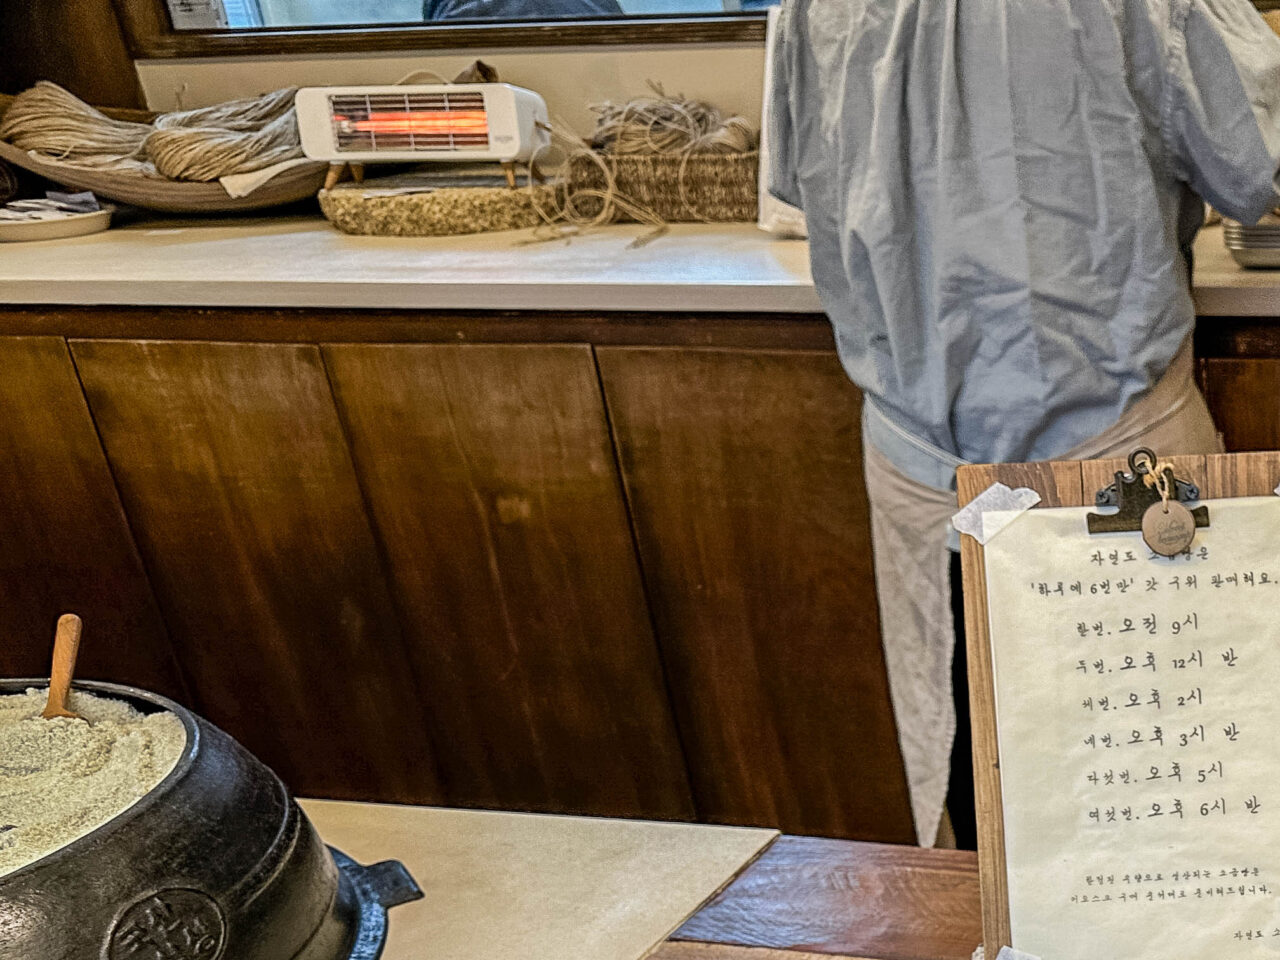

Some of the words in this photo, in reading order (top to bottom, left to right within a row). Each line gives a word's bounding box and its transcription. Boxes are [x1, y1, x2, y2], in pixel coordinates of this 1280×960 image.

[1118, 612, 1157, 635] 오전
[1171, 612, 1198, 635] 9시
[1119, 651, 1157, 673] 오후
[1171, 649, 1203, 669] 12시
[1221, 647, 1239, 667] 반
[1124, 688, 1161, 710] 오후
[1177, 687, 1203, 707] 2시
[1127, 725, 1164, 747] 오후
[1179, 724, 1205, 747] 3시
[1223, 722, 1240, 742] 반
[1145, 761, 1182, 783] 오후
[1197, 760, 1223, 784] 5시
[1147, 798, 1184, 820] 오후
[1199, 797, 1226, 817] 6시
[1244, 794, 1262, 815] 반
